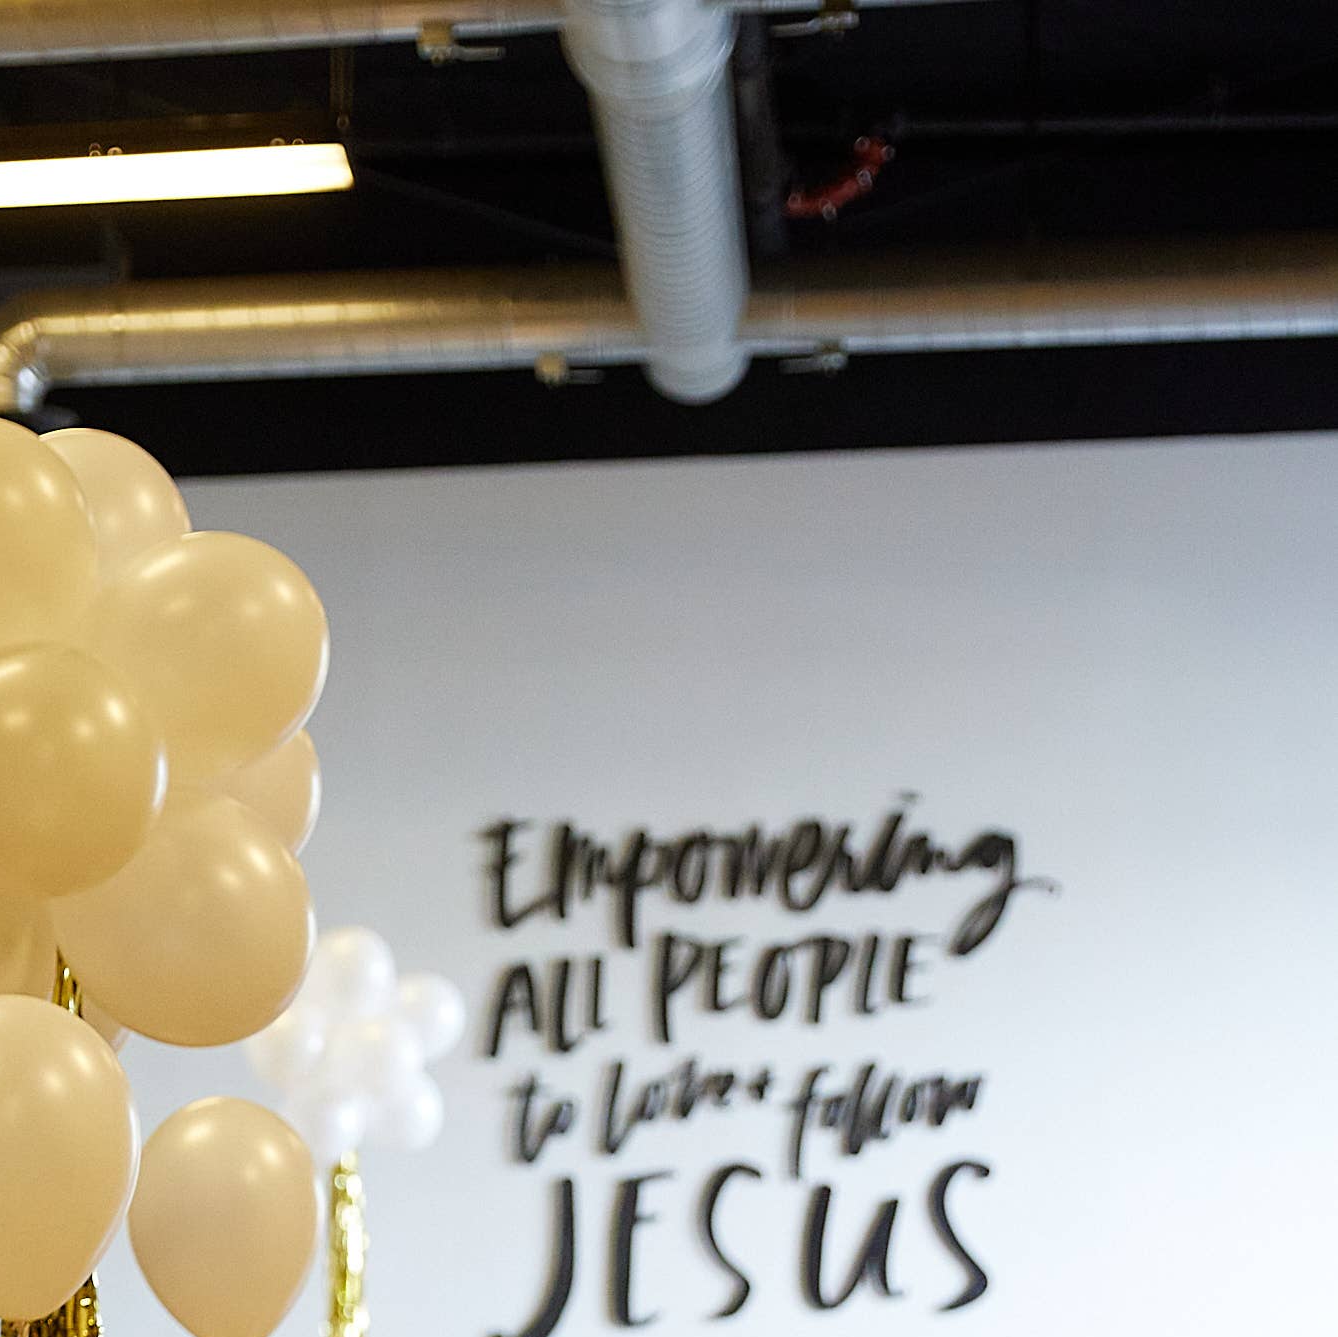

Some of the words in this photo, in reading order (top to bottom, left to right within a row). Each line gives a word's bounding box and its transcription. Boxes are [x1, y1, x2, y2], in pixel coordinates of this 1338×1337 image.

[476, 790, 1062, 956] Empowering
[506, 1072, 574, 1163] to
[791, 1062, 985, 1179] follow
